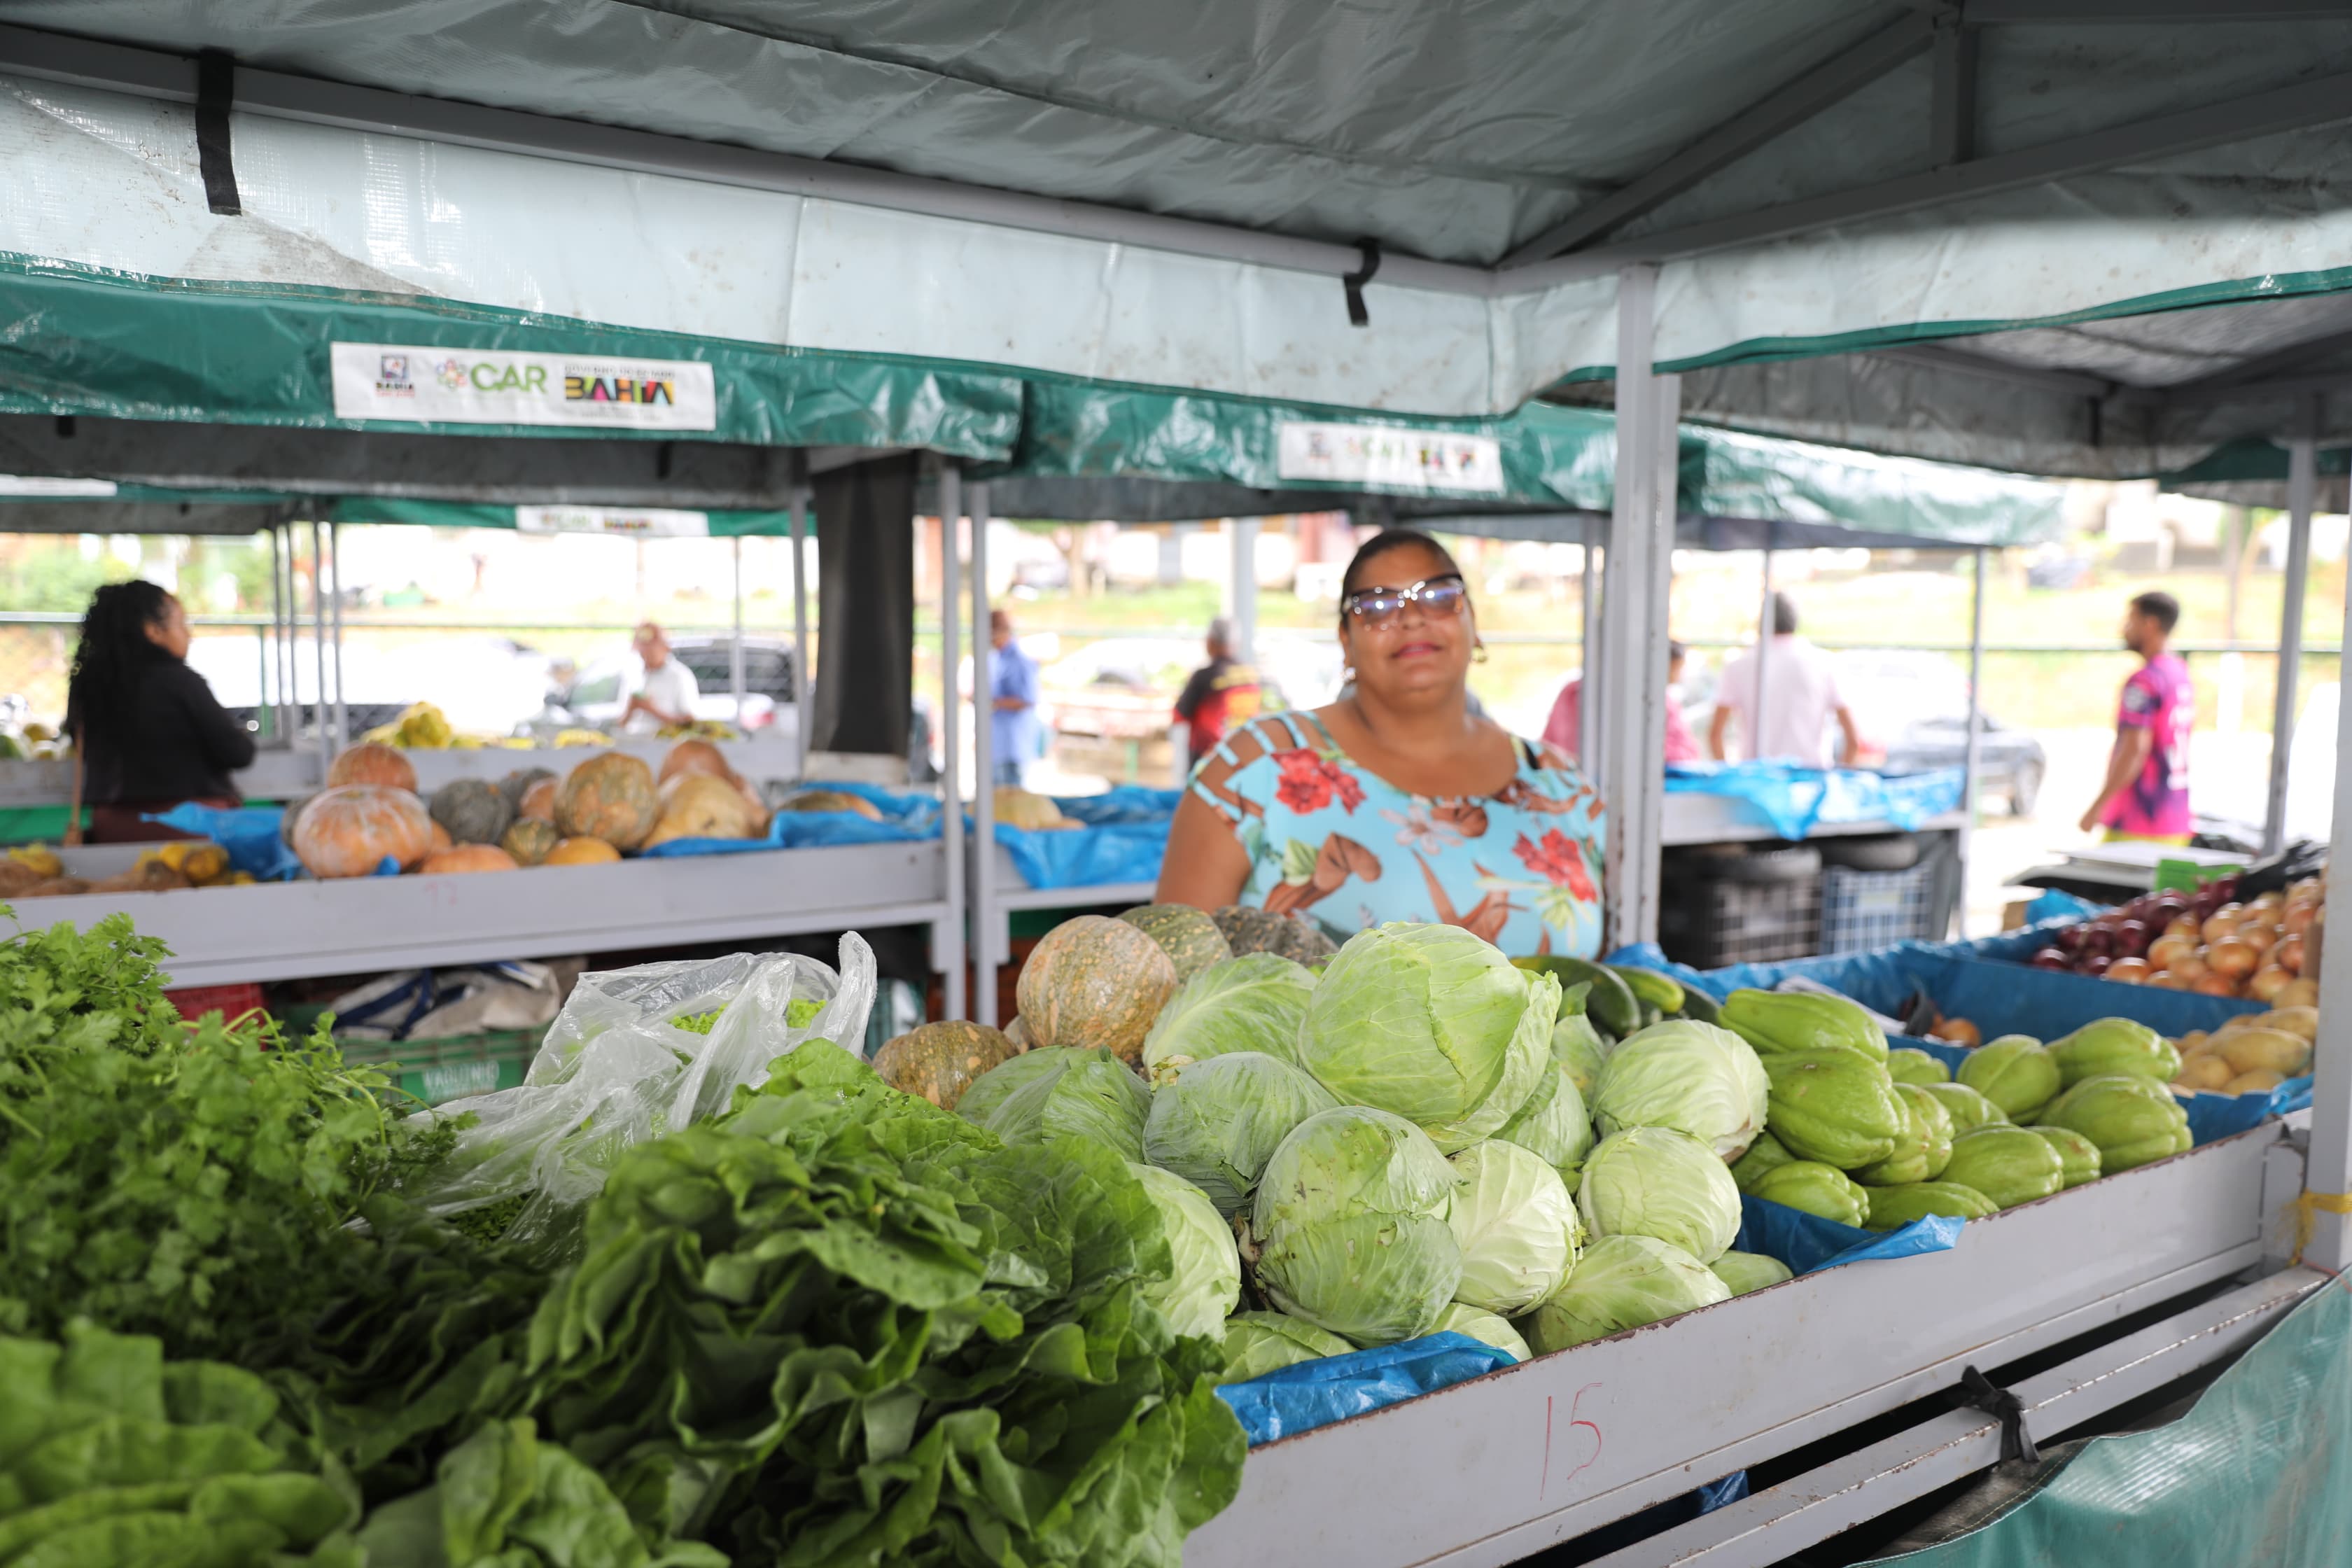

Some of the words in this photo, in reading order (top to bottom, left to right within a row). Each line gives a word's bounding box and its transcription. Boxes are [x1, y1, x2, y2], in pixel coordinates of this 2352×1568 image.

[470, 363, 548, 393] CAR
[565, 377, 676, 406] BAHIA
[1540, 1382, 1602, 1502] 15
